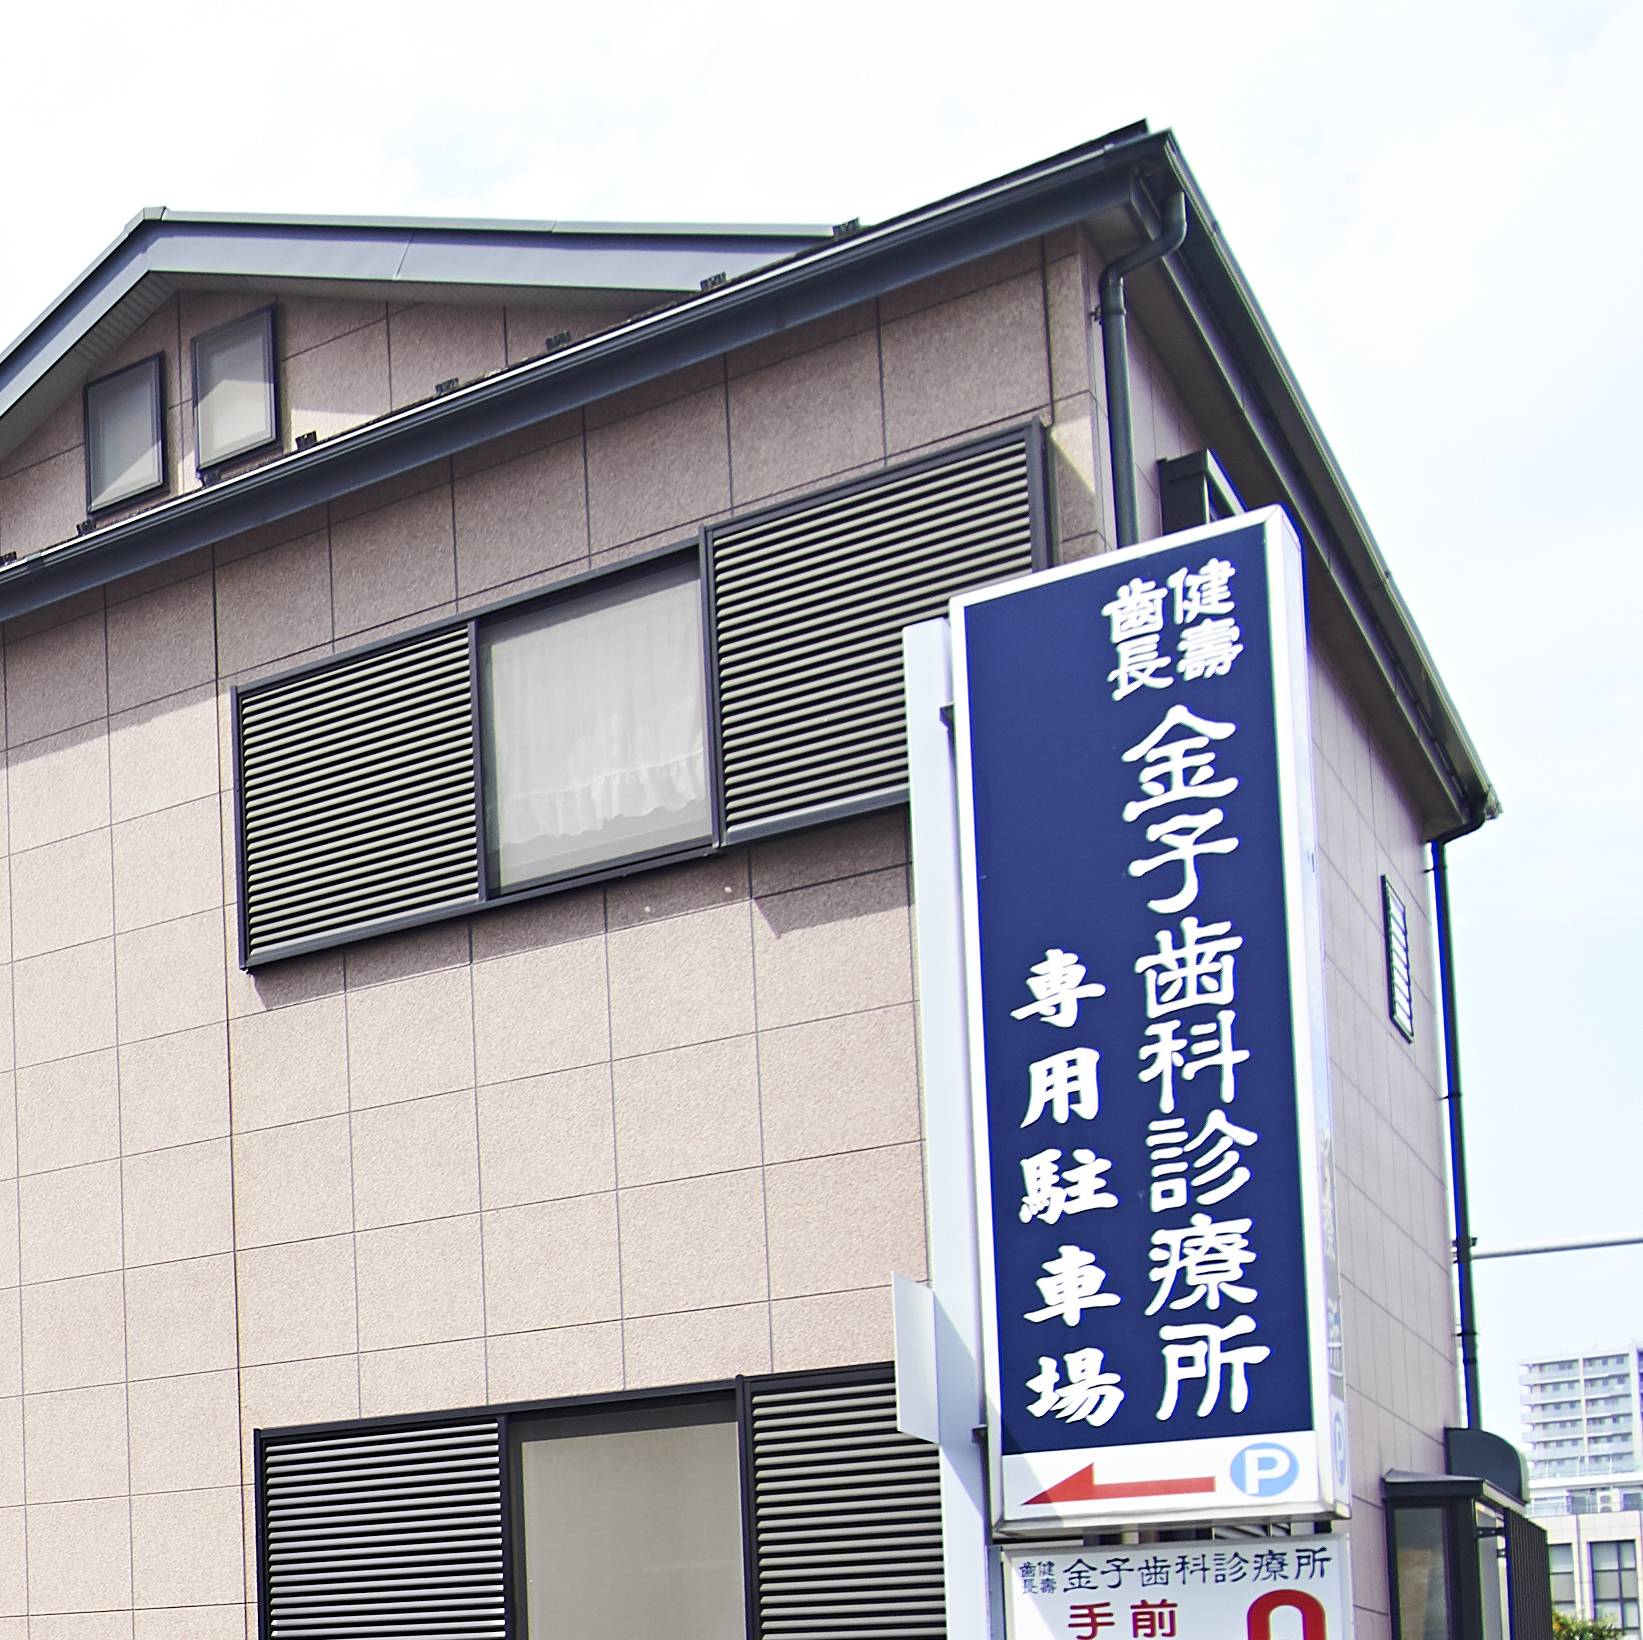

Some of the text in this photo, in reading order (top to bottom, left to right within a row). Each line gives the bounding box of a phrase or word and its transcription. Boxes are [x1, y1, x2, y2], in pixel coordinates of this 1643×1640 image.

[1009, 947, 1126, 1428] 専用駐車場
[1121, 703, 1271, 1423] 金子歯科診療所
[1063, 1547, 1333, 1593] 金子歯科診療所
[1246, 1448, 1290, 1494] P
